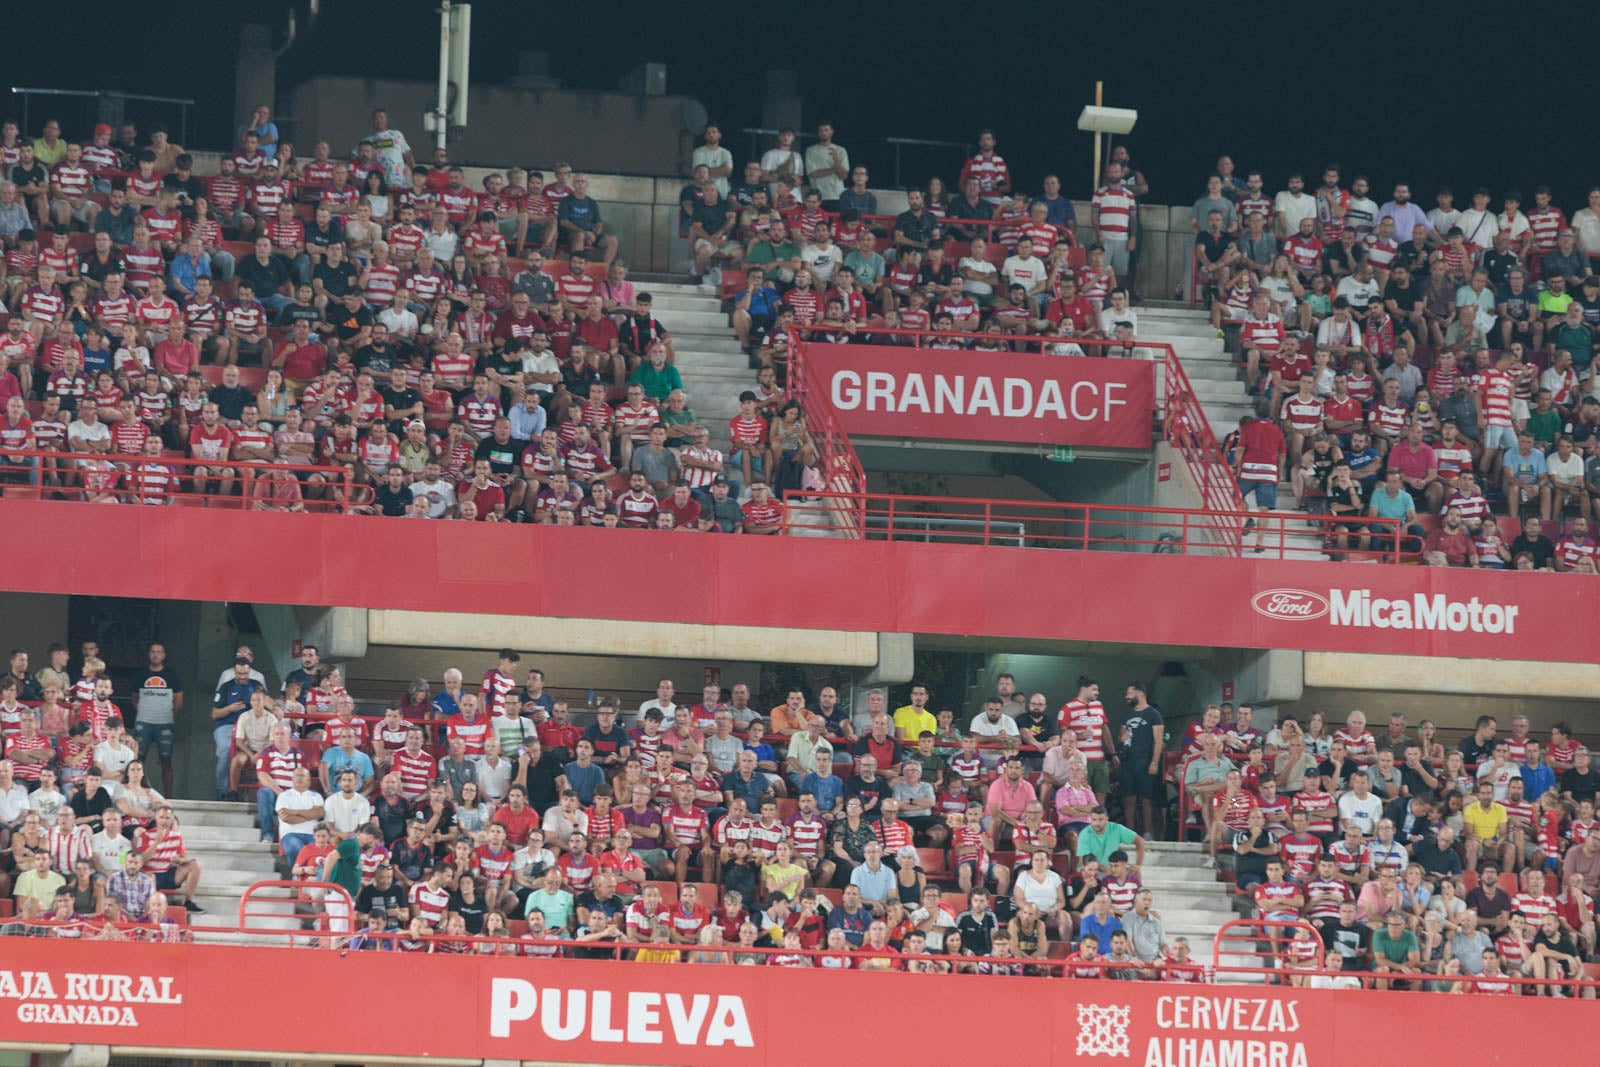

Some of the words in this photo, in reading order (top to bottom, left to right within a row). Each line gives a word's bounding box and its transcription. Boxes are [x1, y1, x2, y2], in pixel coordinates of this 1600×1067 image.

[1267, 593, 1313, 617] Ford
[1329, 589, 1519, 634] MicaMotor
[0, 970, 58, 1000] AJA
[65, 974, 182, 1004] RURAL
[17, 1003, 138, 1027] GRANADA
[490, 977, 755, 1048] PULEVA
[1156, 995, 1300, 1032] CERVEZAS
[1144, 1037, 1308, 1067] ALHAMBRA
